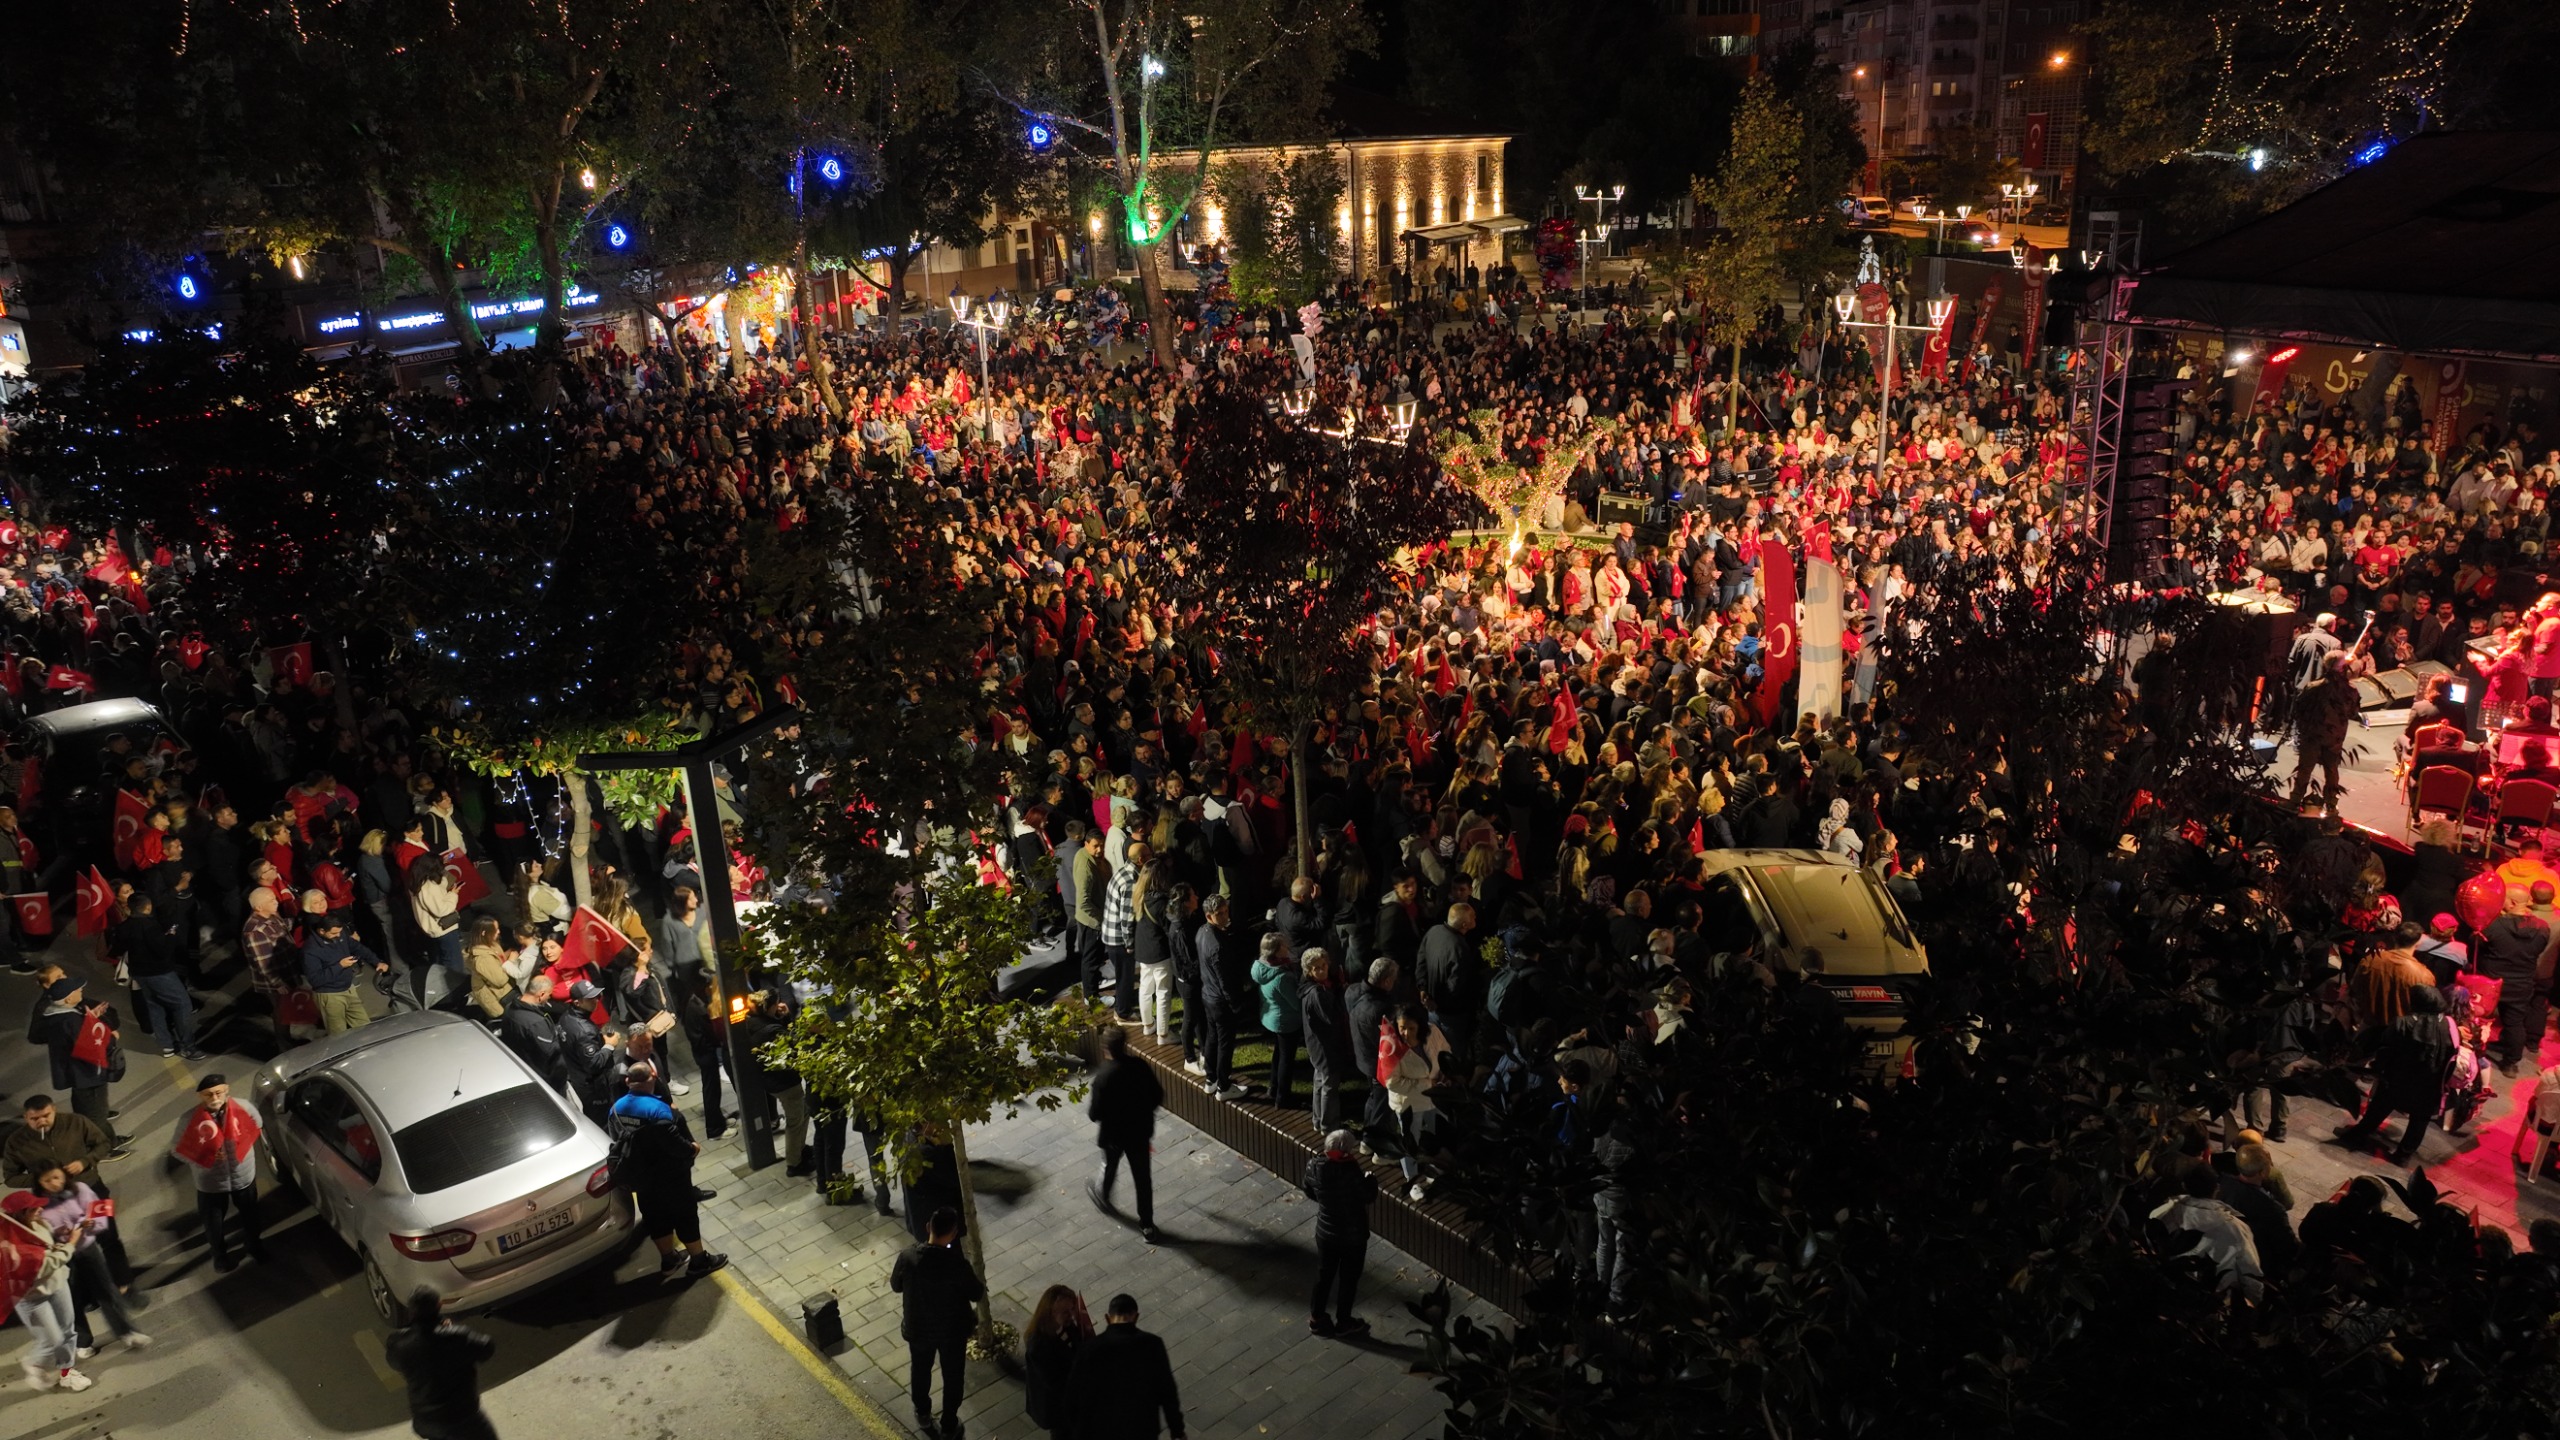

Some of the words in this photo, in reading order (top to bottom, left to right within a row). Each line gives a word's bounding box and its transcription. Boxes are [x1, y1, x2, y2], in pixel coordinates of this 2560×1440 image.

[2452, 396, 2461, 420] CHP
[2440, 397, 2453, 451] BALIKESİR
[1830, 990, 1854, 999] ANLI
[1854, 990, 1885, 999] YAYIN
[507, 1232, 521, 1246] 10
[526, 1222, 546, 1239] AJZ
[548, 1212, 569, 1229] 579
